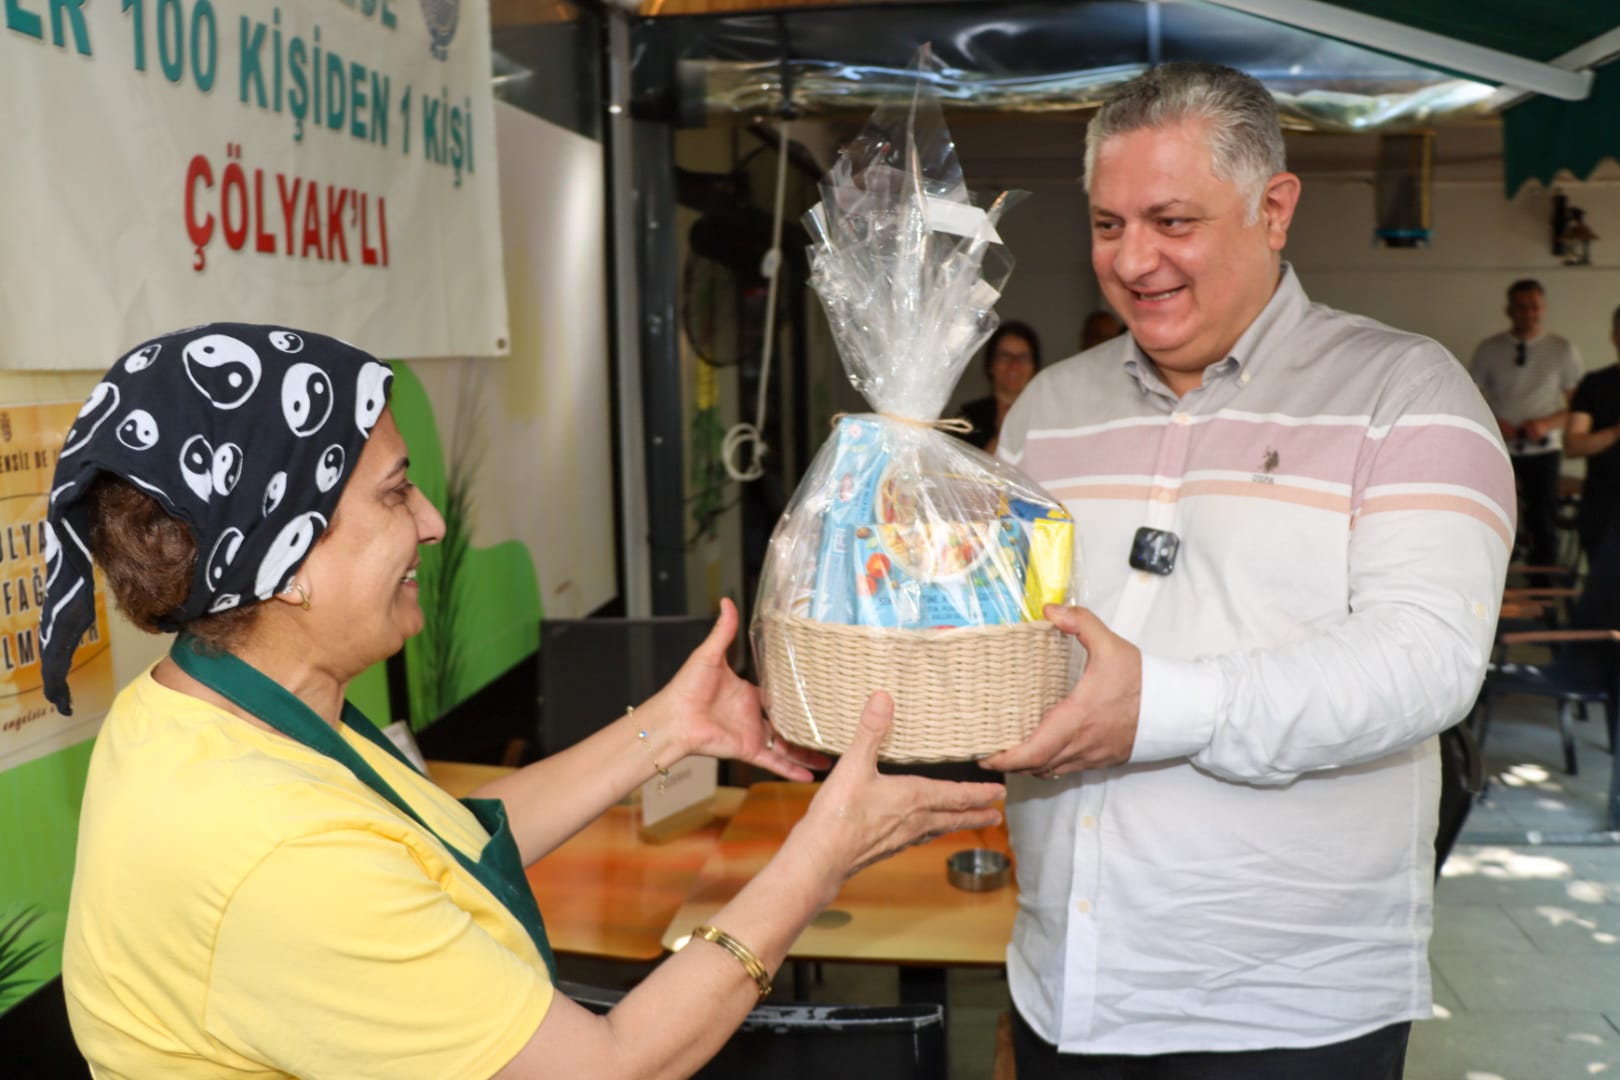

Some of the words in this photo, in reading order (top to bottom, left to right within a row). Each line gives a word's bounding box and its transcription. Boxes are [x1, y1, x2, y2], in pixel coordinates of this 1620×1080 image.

[121, 0, 217, 92] 100
[240, 8, 390, 148] KİŞİDEN
[399, 86, 411, 155] 1
[422, 86, 475, 188] KİŞİ
[185, 143, 389, 271] ÇÖLYAK'LI
